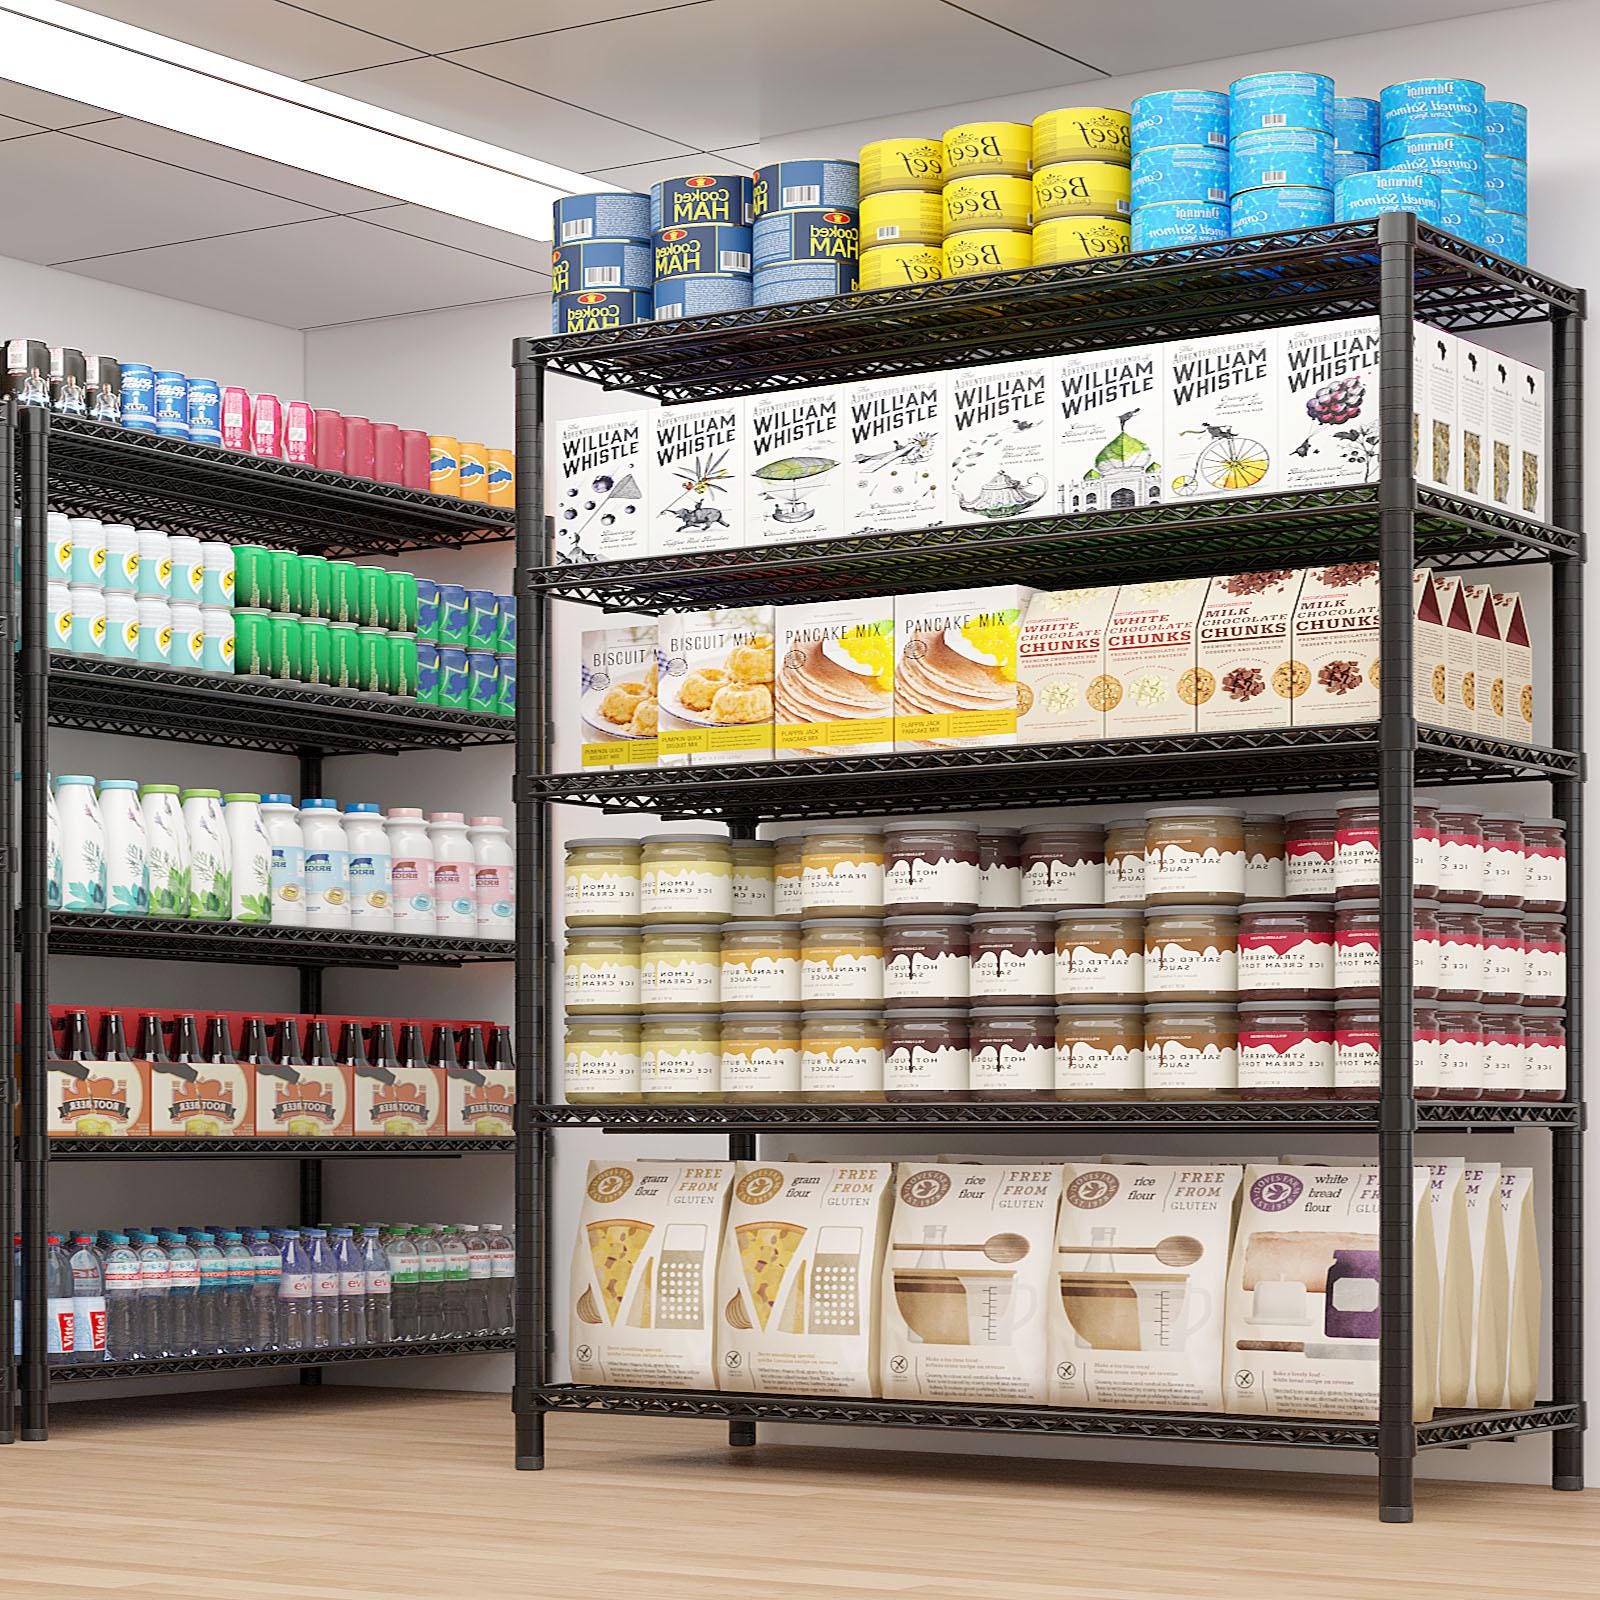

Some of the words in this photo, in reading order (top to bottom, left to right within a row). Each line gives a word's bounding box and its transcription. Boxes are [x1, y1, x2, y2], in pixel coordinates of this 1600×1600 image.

[1288, 334, 1380, 372] WILLIAM
[1172, 348, 1268, 386] WILLIAM
[1288, 350, 1380, 394] WHISTLE
[1061, 360, 1154, 398] WILLIAM
[1172, 364, 1268, 406] WHISTLE
[954, 375, 1046, 410] WILLIAM
[1061, 376, 1154, 420] WHISTLE
[851, 389, 938, 424] WILLIAM
[954, 390, 1046, 432] WHISTLE
[753, 401, 836, 436] WILLIAM
[851, 404, 938, 444] WHISTLE
[656, 414, 736, 447] WILLIAM
[753, 416, 837, 456] WHISTLE
[562, 426, 640, 459] WILLIAM
[656, 428, 736, 466] WHISTLE
[562, 442, 640, 478] WHISTLE
[1299, 599, 1347, 610] MILK
[1204, 607, 1250, 618] MILK
[905, 614, 971, 634] PANCAKE
[978, 612, 1006, 628] MIX
[1112, 614, 1170, 626] WHITE
[1202, 613, 1288, 627] CHOCOLATE
[1296, 615, 1380, 632] CHUNKS
[785, 625, 849, 644] PANCAKE
[856, 622, 882, 639] MIX
[1020, 628, 1102, 642] CHOCOLATE
[1024, 622, 1080, 634] WHITE
[1109, 621, 1194, 635] CHOCOLATE
[1200, 622, 1287, 639] CHUNKS
[670, 634, 724, 652] BISCUIT
[732, 631, 758, 647] MIX
[1108, 630, 1192, 647] CHUNKS
[1019, 638, 1100, 654] CHUNKS
[592, 650, 645, 667] BISCUIT
[640, 1174, 668, 1186] gram
[684, 1168, 722, 1179] FREE
[838, 1169, 878, 1180] FREE
[964, 1175, 986, 1186] rice
[1008, 1170, 1052, 1182] FREE
[1180, 1172, 1225, 1183] FREE
[1314, 1174, 1349, 1184] white
[678, 1181, 719, 1192] FROM
[792, 1175, 820, 1188] gram
[832, 1182, 874, 1193] FROM
[1134, 1176, 1156, 1186] rice
[634, 1186, 660, 1197] flour
[786, 1188, 812, 1198] flour
[958, 1188, 986, 1199] flour
[1004, 1184, 1048, 1196] FROM
[1127, 1189, 1156, 1201] flour
[1174, 1186, 1221, 1198] FROM
[1308, 1188, 1343, 1198] bread
[673, 1195, 715, 1205] GLUTEN
[827, 1196, 870, 1206] GLUTEN
[998, 1199, 1044, 1209] GLUTEN
[1170, 1200, 1218, 1211] GLUTEN
[1304, 1202, 1332, 1212] flour
[1356, 1204, 1380, 1214] GLU
[62, 1316, 74, 1348] Vittel
[94, 1314, 106, 1347] Vittel
